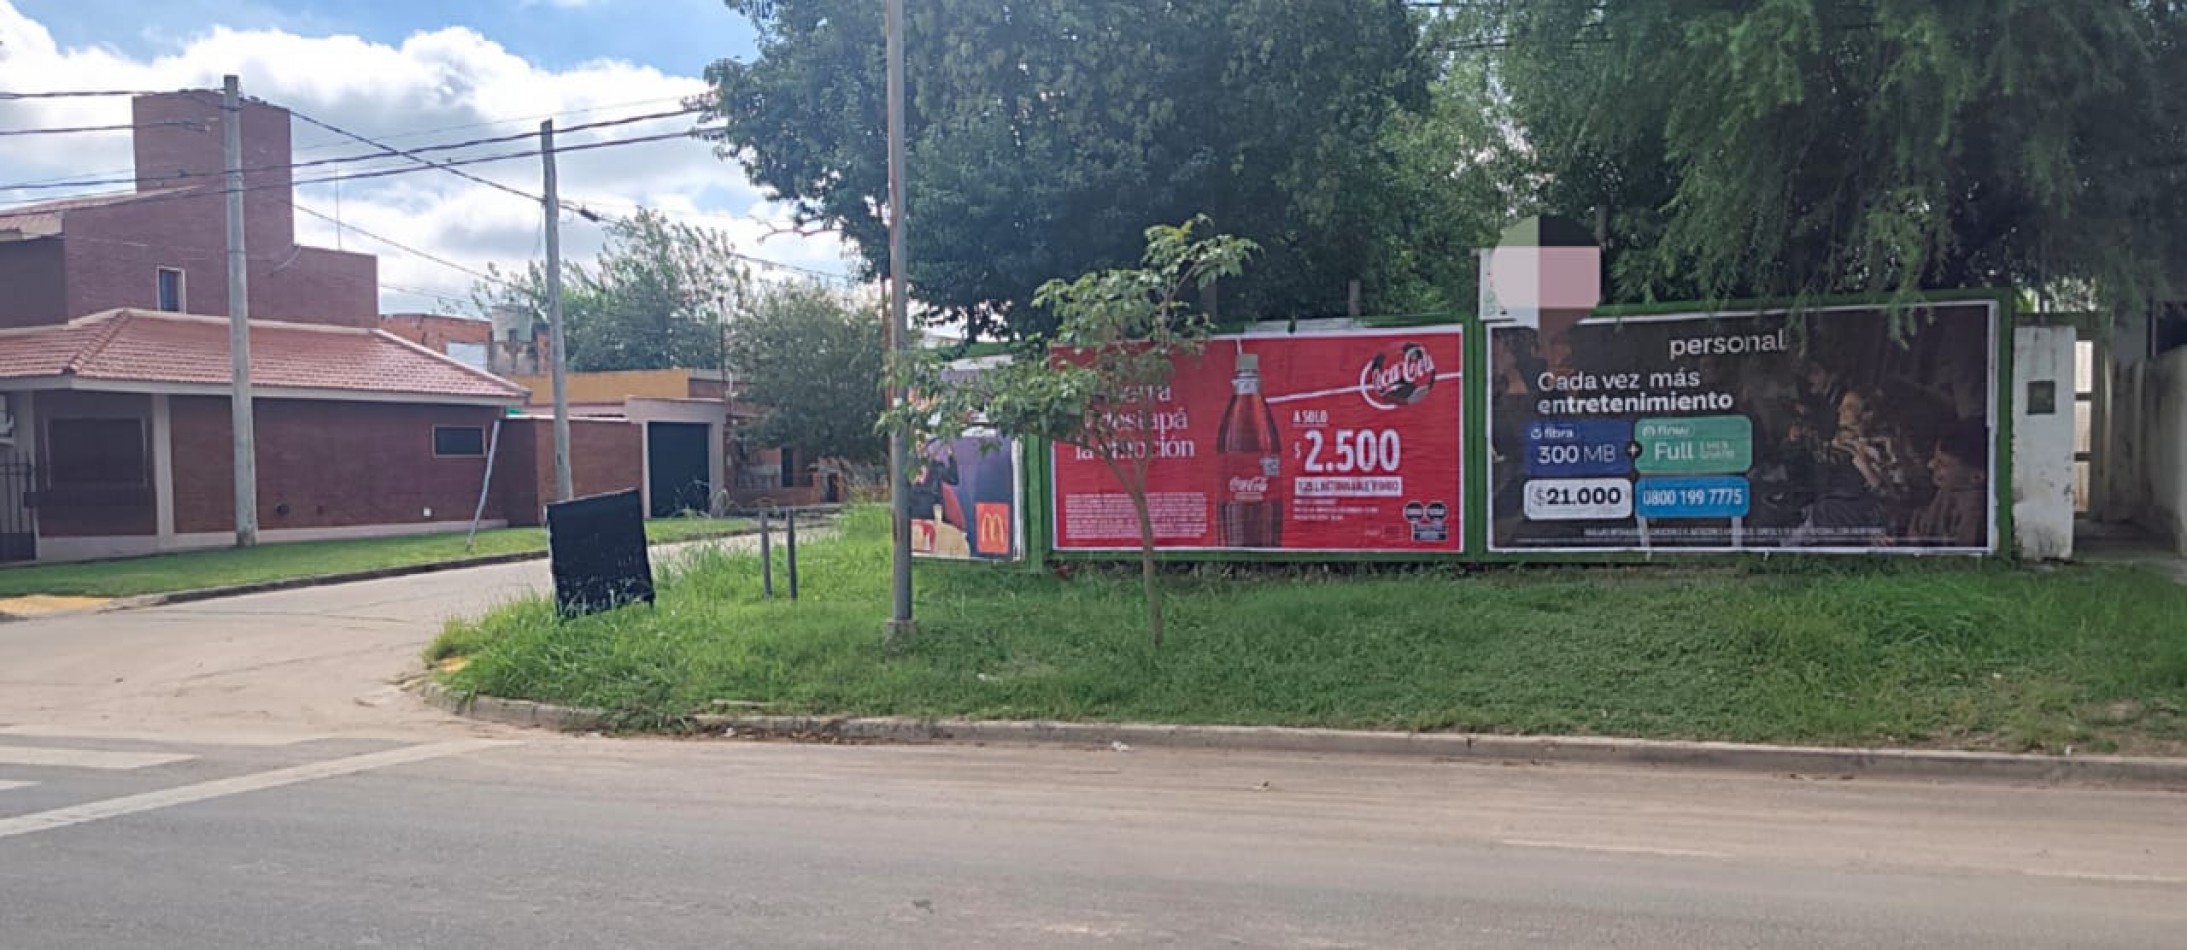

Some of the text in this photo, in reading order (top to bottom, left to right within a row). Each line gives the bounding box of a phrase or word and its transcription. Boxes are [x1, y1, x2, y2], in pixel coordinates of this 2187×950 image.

[1668, 328, 1786, 360] personal
[1537, 367, 1701, 392] Cada vez más
[1537, 391, 1733, 415] entretenimiento
[1544, 426, 1574, 438] fibra
[1538, 444, 1616, 464] 300 MB
[1655, 441, 1694, 461] Full
[1534, 486, 1622, 506] $21.000
[1643, 487, 1743, 506] 0800 199 7775
